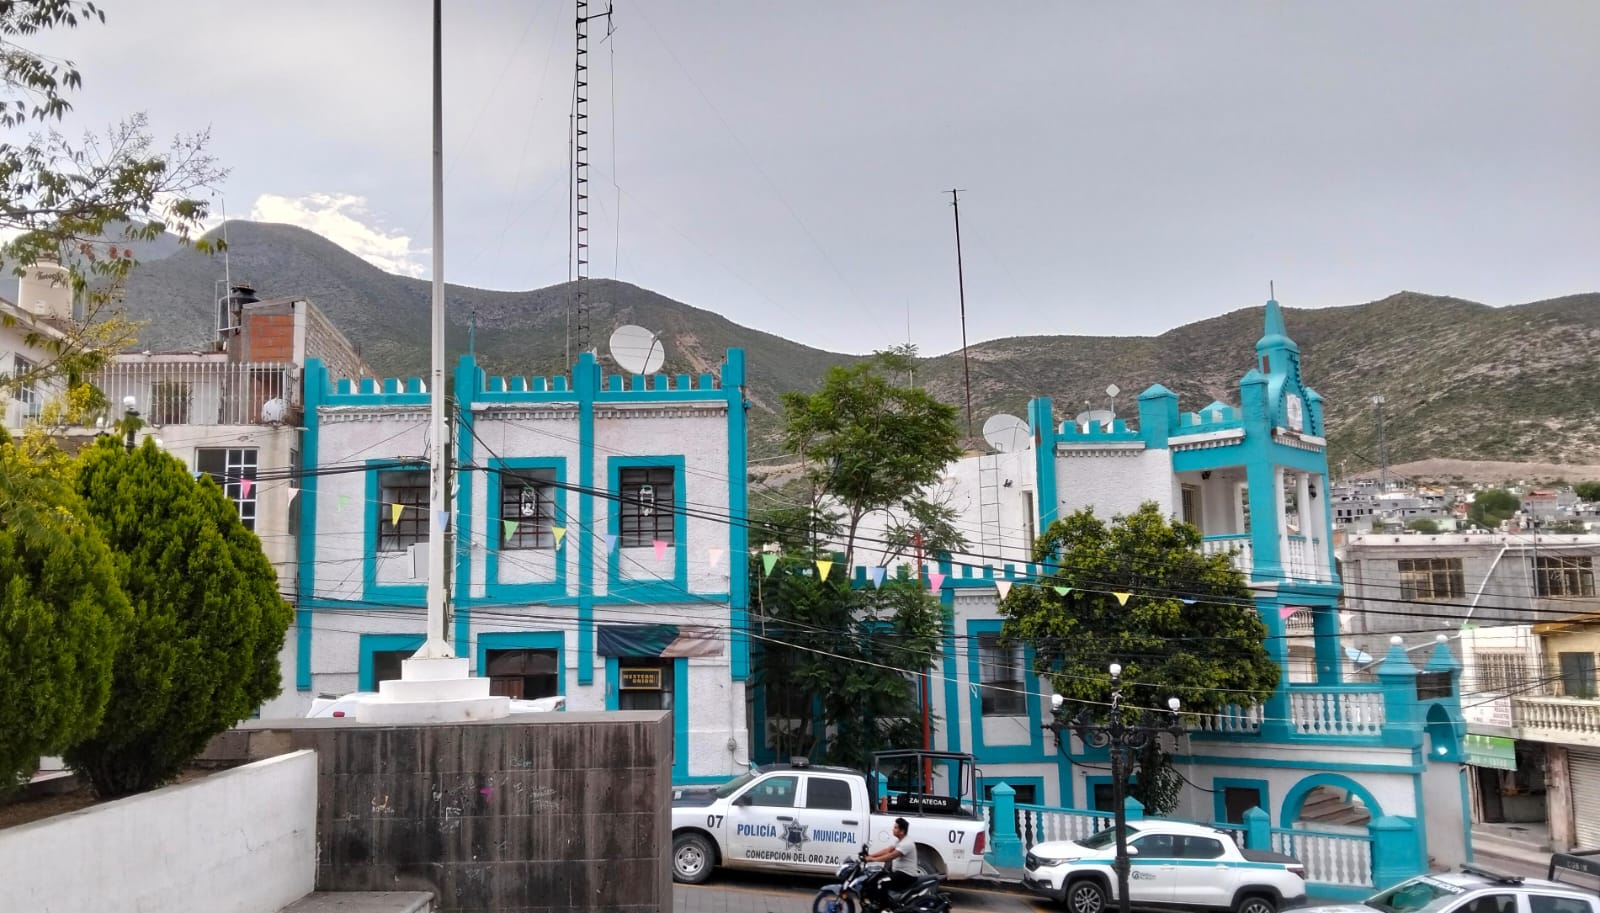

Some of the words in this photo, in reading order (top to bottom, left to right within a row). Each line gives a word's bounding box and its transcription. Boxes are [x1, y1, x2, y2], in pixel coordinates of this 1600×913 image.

[909, 797, 947, 806] ZAATECAS
[707, 814, 723, 828] 07
[737, 823, 777, 838] POLICÍA
[813, 829, 856, 843] MUNICIPAL
[948, 830, 965, 844] 07
[746, 850, 793, 861] CONCEPCION
[794, 853, 806, 863] DEL
[809, 854, 823, 863] ORO
[825, 855, 841, 865] ZAC.
